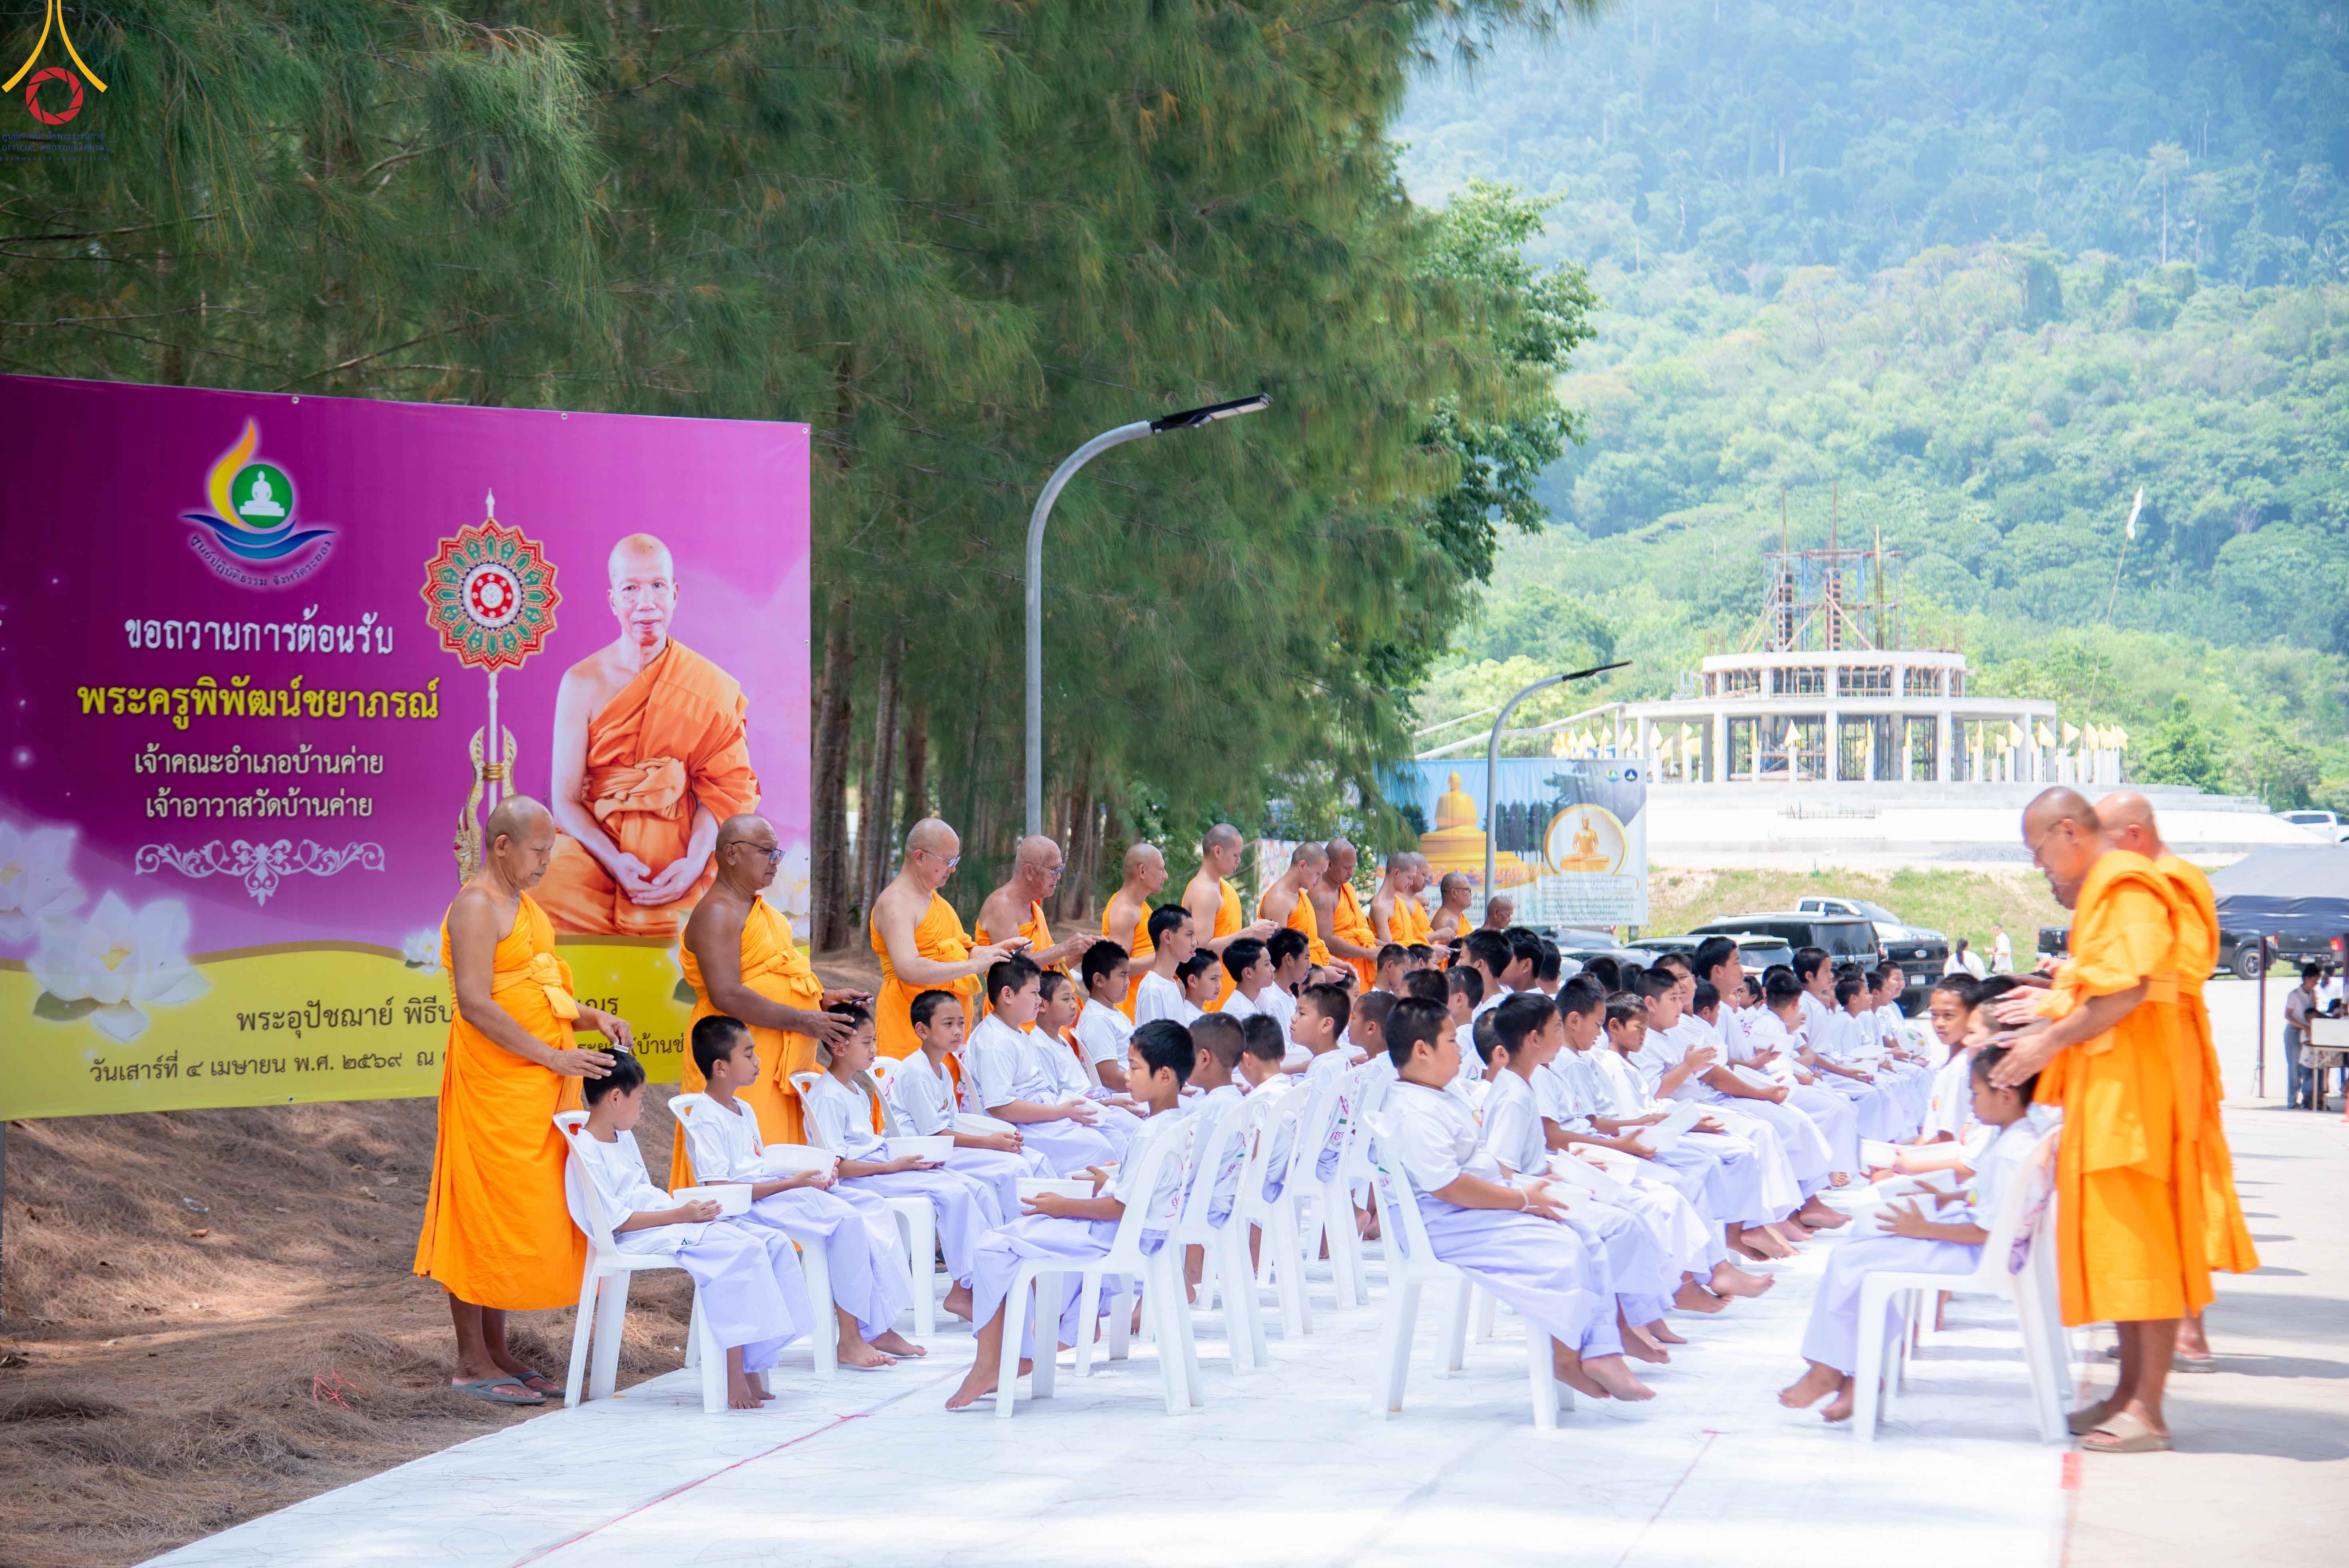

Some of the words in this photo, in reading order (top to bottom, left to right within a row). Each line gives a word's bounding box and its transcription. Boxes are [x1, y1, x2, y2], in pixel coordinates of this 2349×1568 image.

[191, 535, 267, 586] ศูนย์ปฏิบัติธรรม
[273, 541, 332, 585] จังหวัดระยอง
[125, 603, 393, 654] ขอถวายการต้อนรับ
[77, 675, 439, 730] พระครูพิพัฒน์ชยาภรณ์
[135, 743, 383, 774] เจ้าคณะอำเภอบ้านค่าย
[146, 787, 372, 818] เจ้าอาวาสวัดบ้านค่าย
[236, 996, 393, 1039] พระอุปัชฌาย์
[89, 1049, 178, 1082] วันเสาร์ที่
[187, 1061, 204, 1077] ๔
[211, 1058, 286, 1076] เมษายน
[294, 1055, 334, 1072] พ.ศ.
[343, 1052, 402, 1070] ๒๕๖๙
[417, 1051, 434, 1066] ณ
